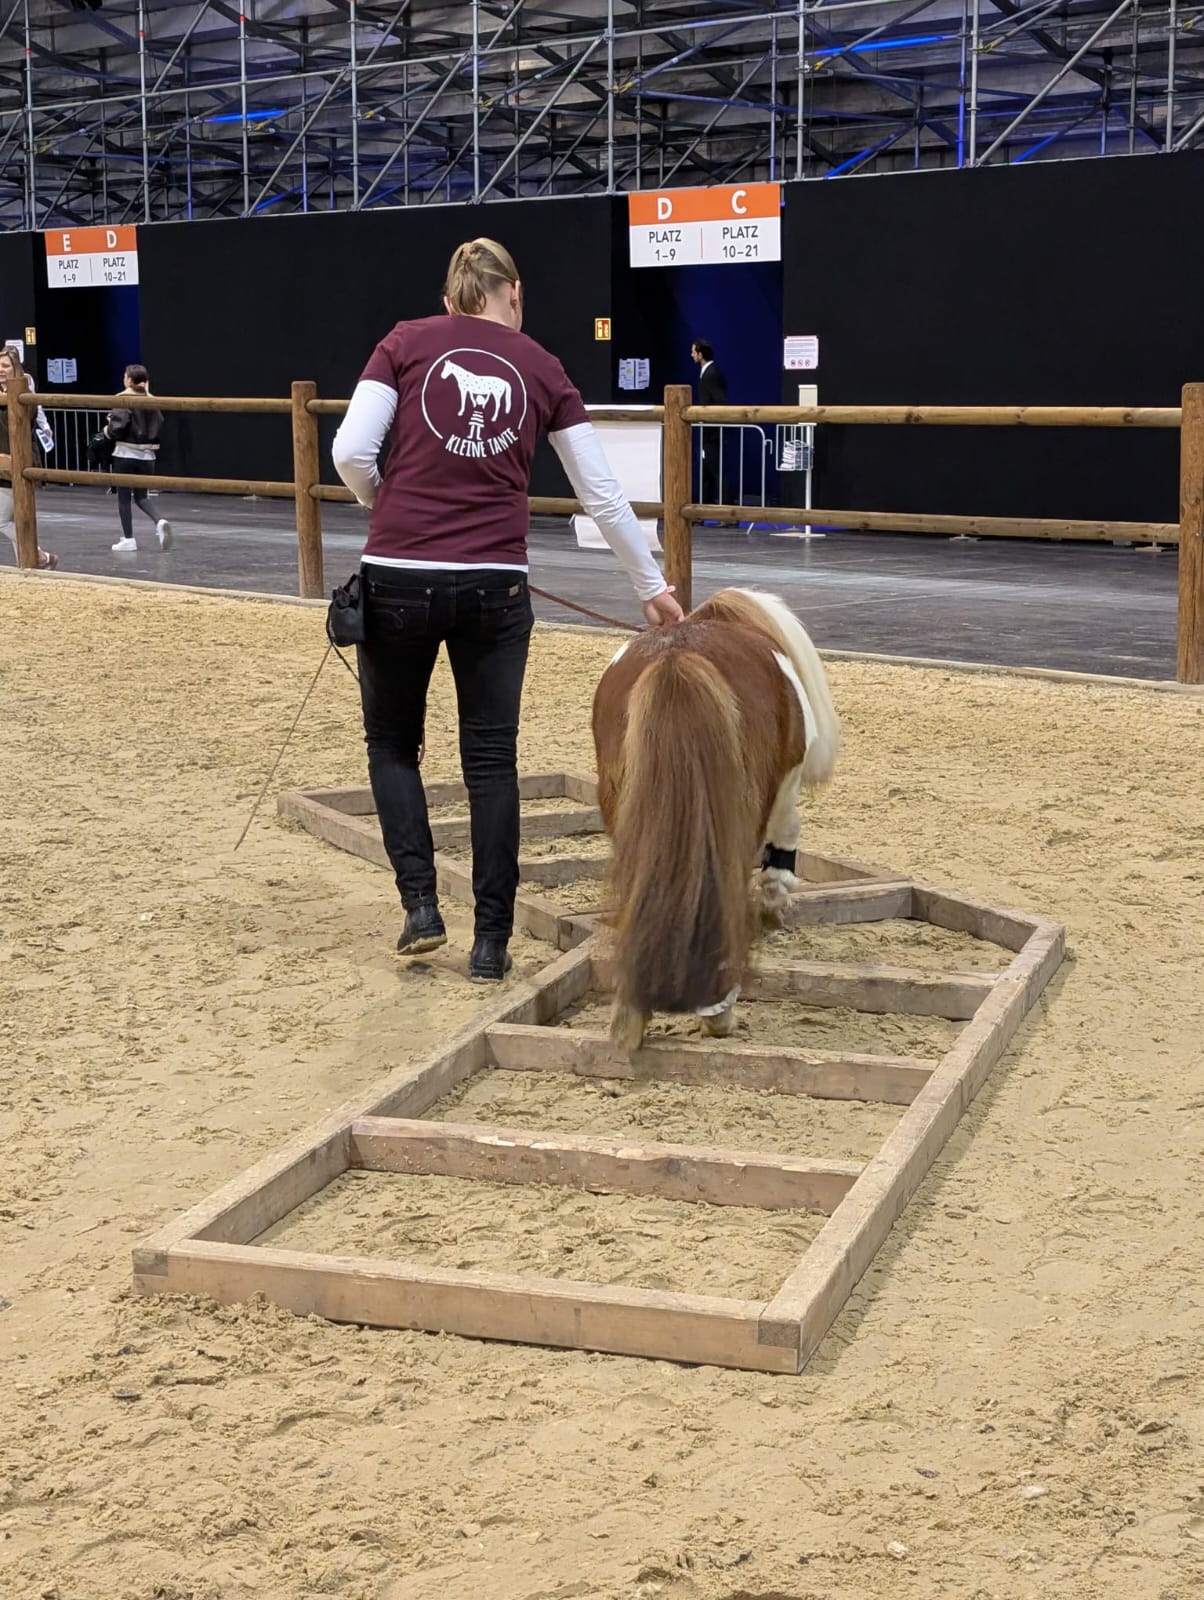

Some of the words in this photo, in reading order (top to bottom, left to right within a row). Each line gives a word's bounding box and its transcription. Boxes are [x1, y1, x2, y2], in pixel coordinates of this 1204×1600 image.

[656, 196, 673, 220] D
[731, 190, 747, 214] C
[648, 230, 682, 243] PLATZ
[722, 225, 759, 239] PLATZ
[62, 233, 72, 252] E
[105, 230, 117, 249] D
[655, 248, 676, 261] 1-9
[722, 244, 758, 258] 10-21
[58, 259, 79, 270] PLATZ
[103, 256, 125, 268] PLATZ
[63, 273, 77, 284] 1-9
[104, 271, 126, 282] 10-21
[445, 434, 487, 458] KLEINE
[487, 427, 519, 456] TANTE
